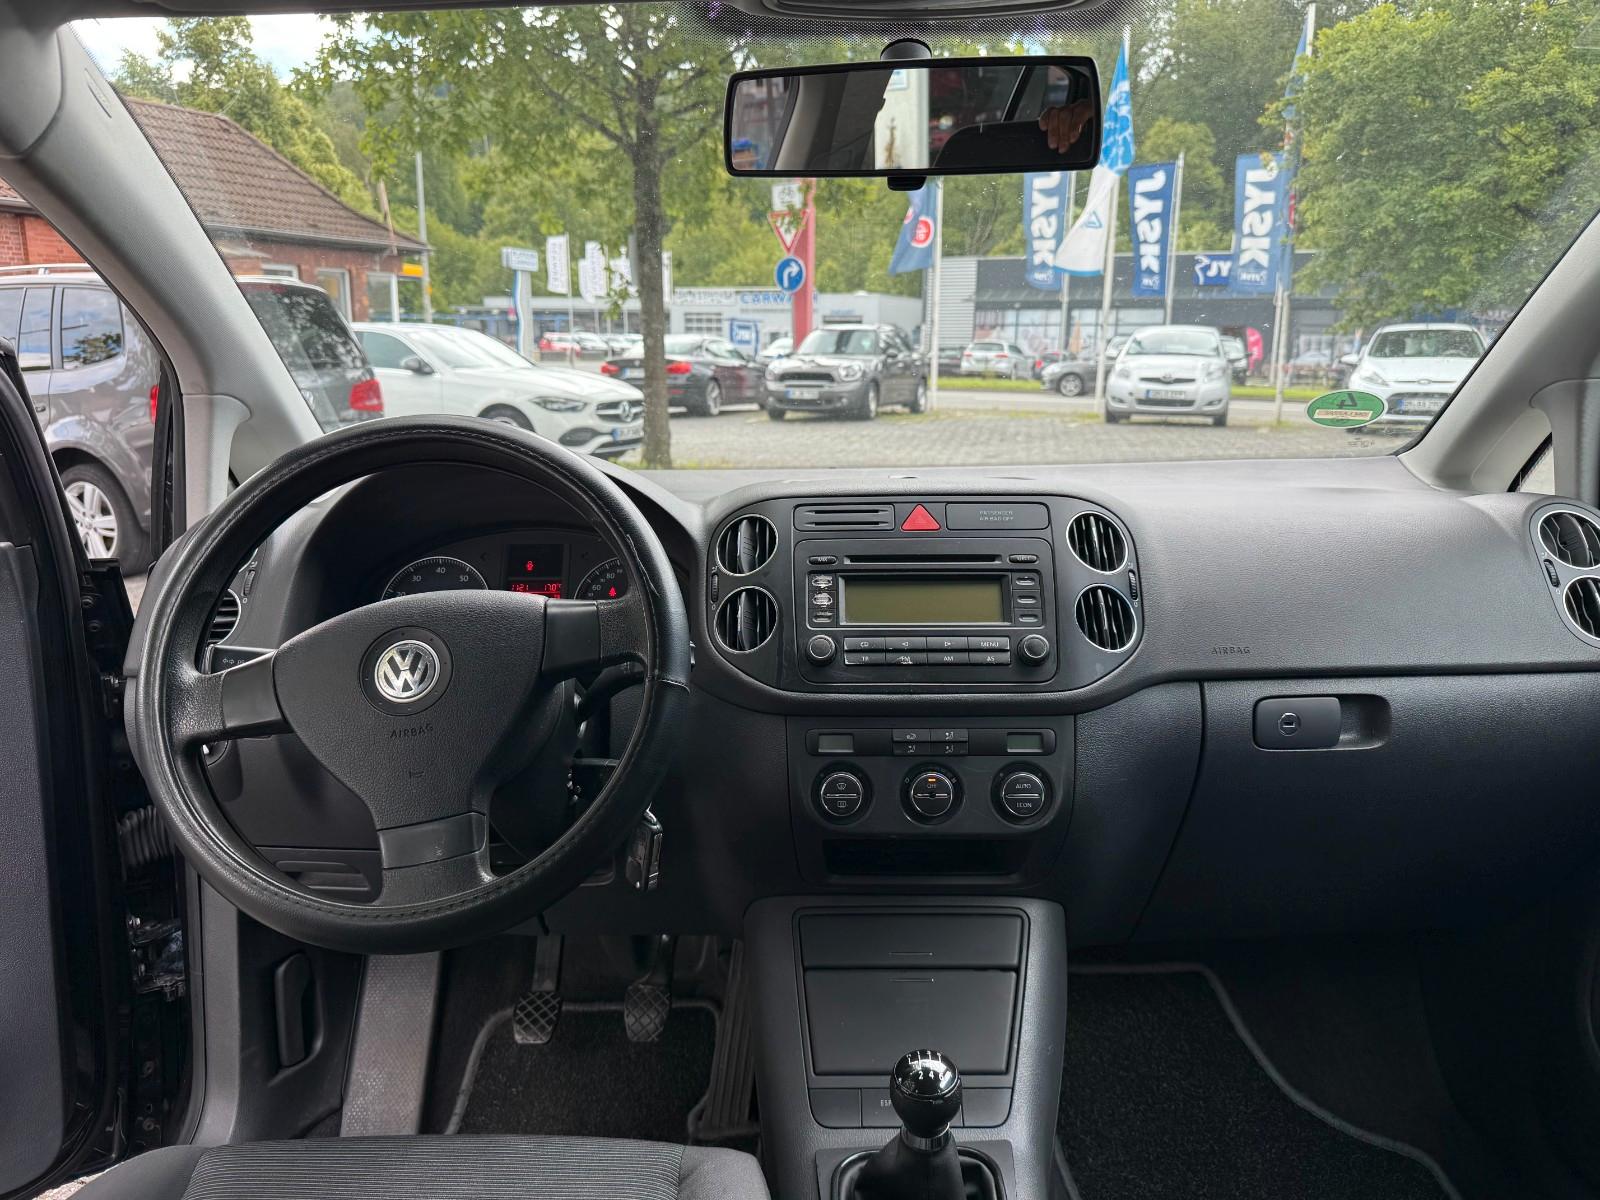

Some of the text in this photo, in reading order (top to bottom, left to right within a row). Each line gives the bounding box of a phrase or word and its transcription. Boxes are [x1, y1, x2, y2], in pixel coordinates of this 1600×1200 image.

[1206, 260, 1232, 277] JY
[1211, 646, 1250, 655] AIRBAG
[389, 723, 433, 739] AIRBAG
[918, 1070, 924, 1080] 2
[928, 1070, 935, 1080] 4
